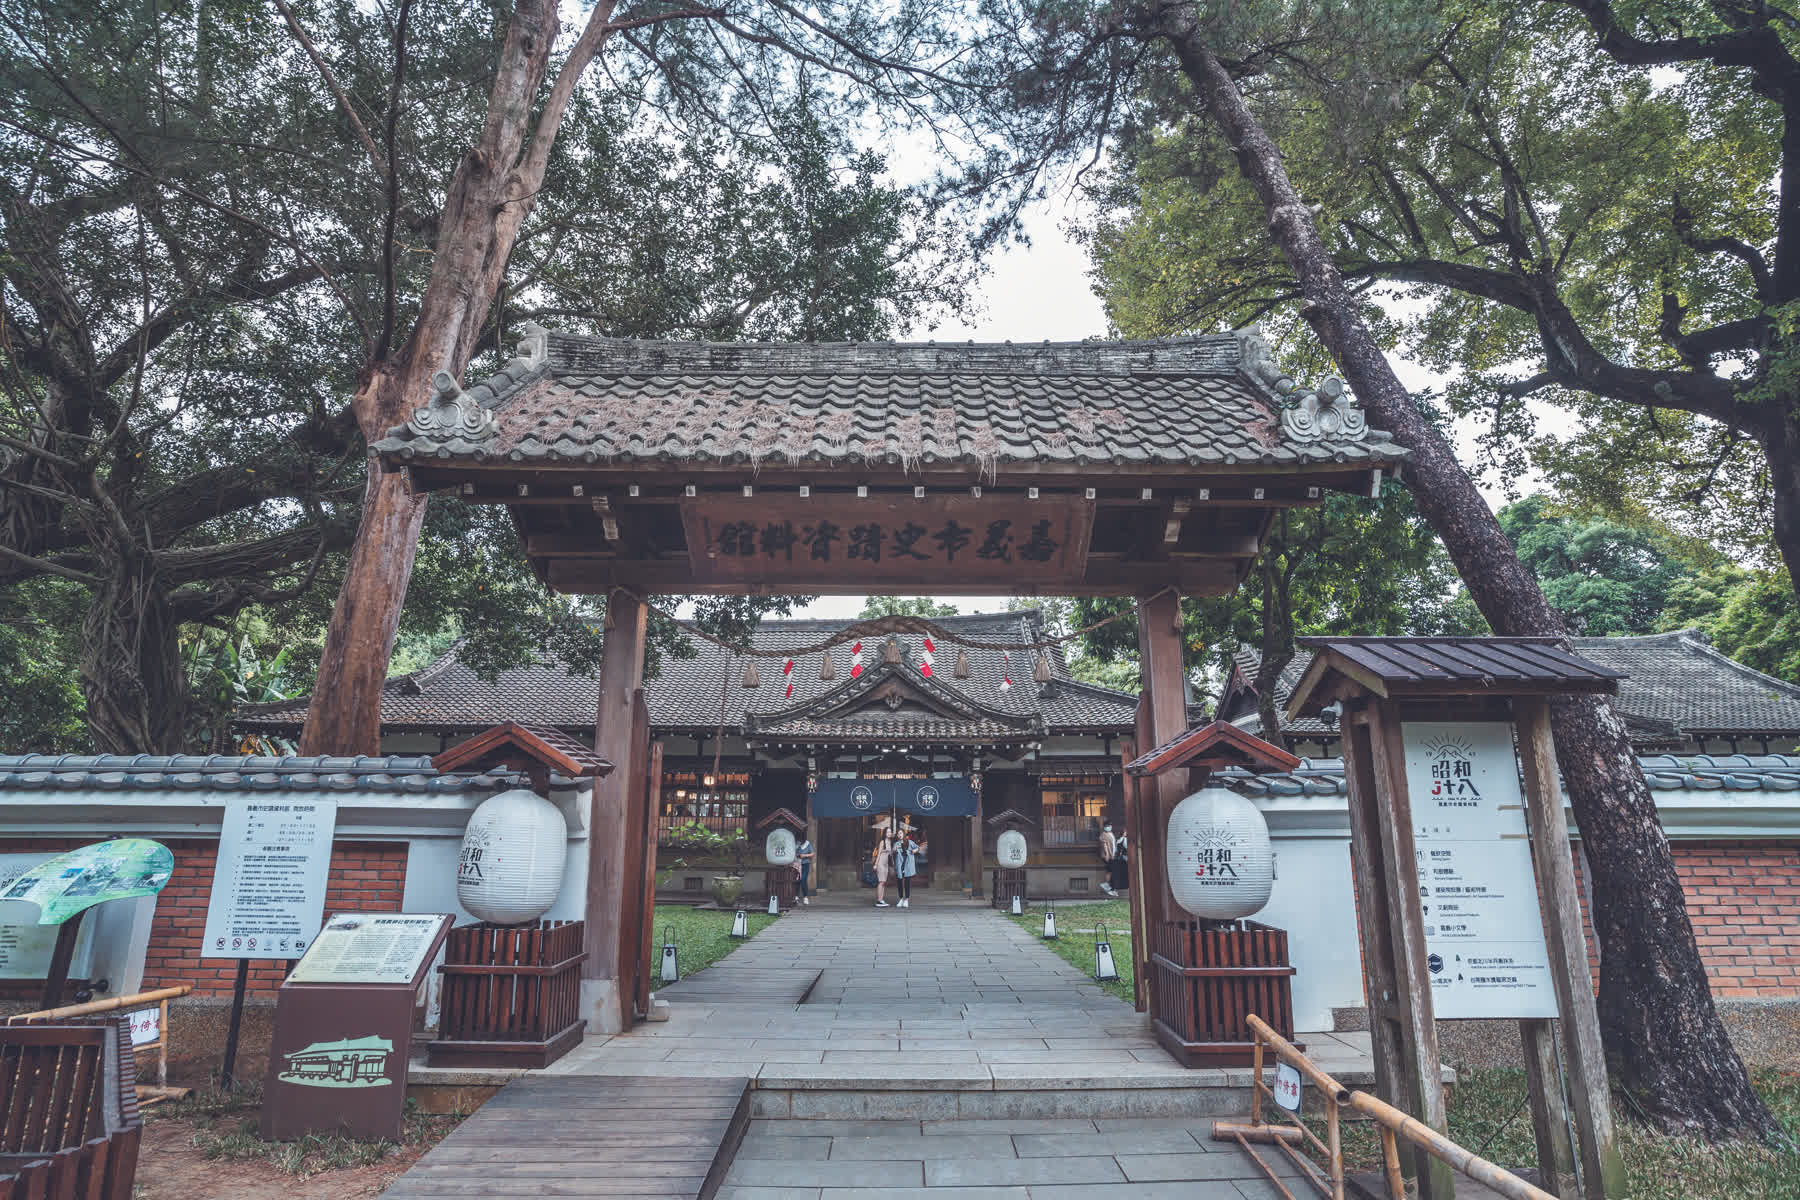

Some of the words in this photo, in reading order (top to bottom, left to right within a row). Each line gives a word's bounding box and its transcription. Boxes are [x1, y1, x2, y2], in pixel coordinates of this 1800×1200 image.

[717, 519, 1059, 563] 嘉義市史蹟資料館
[1432, 760, 1471, 778] 昭和
[1197, 848, 1231, 863] 昭和
